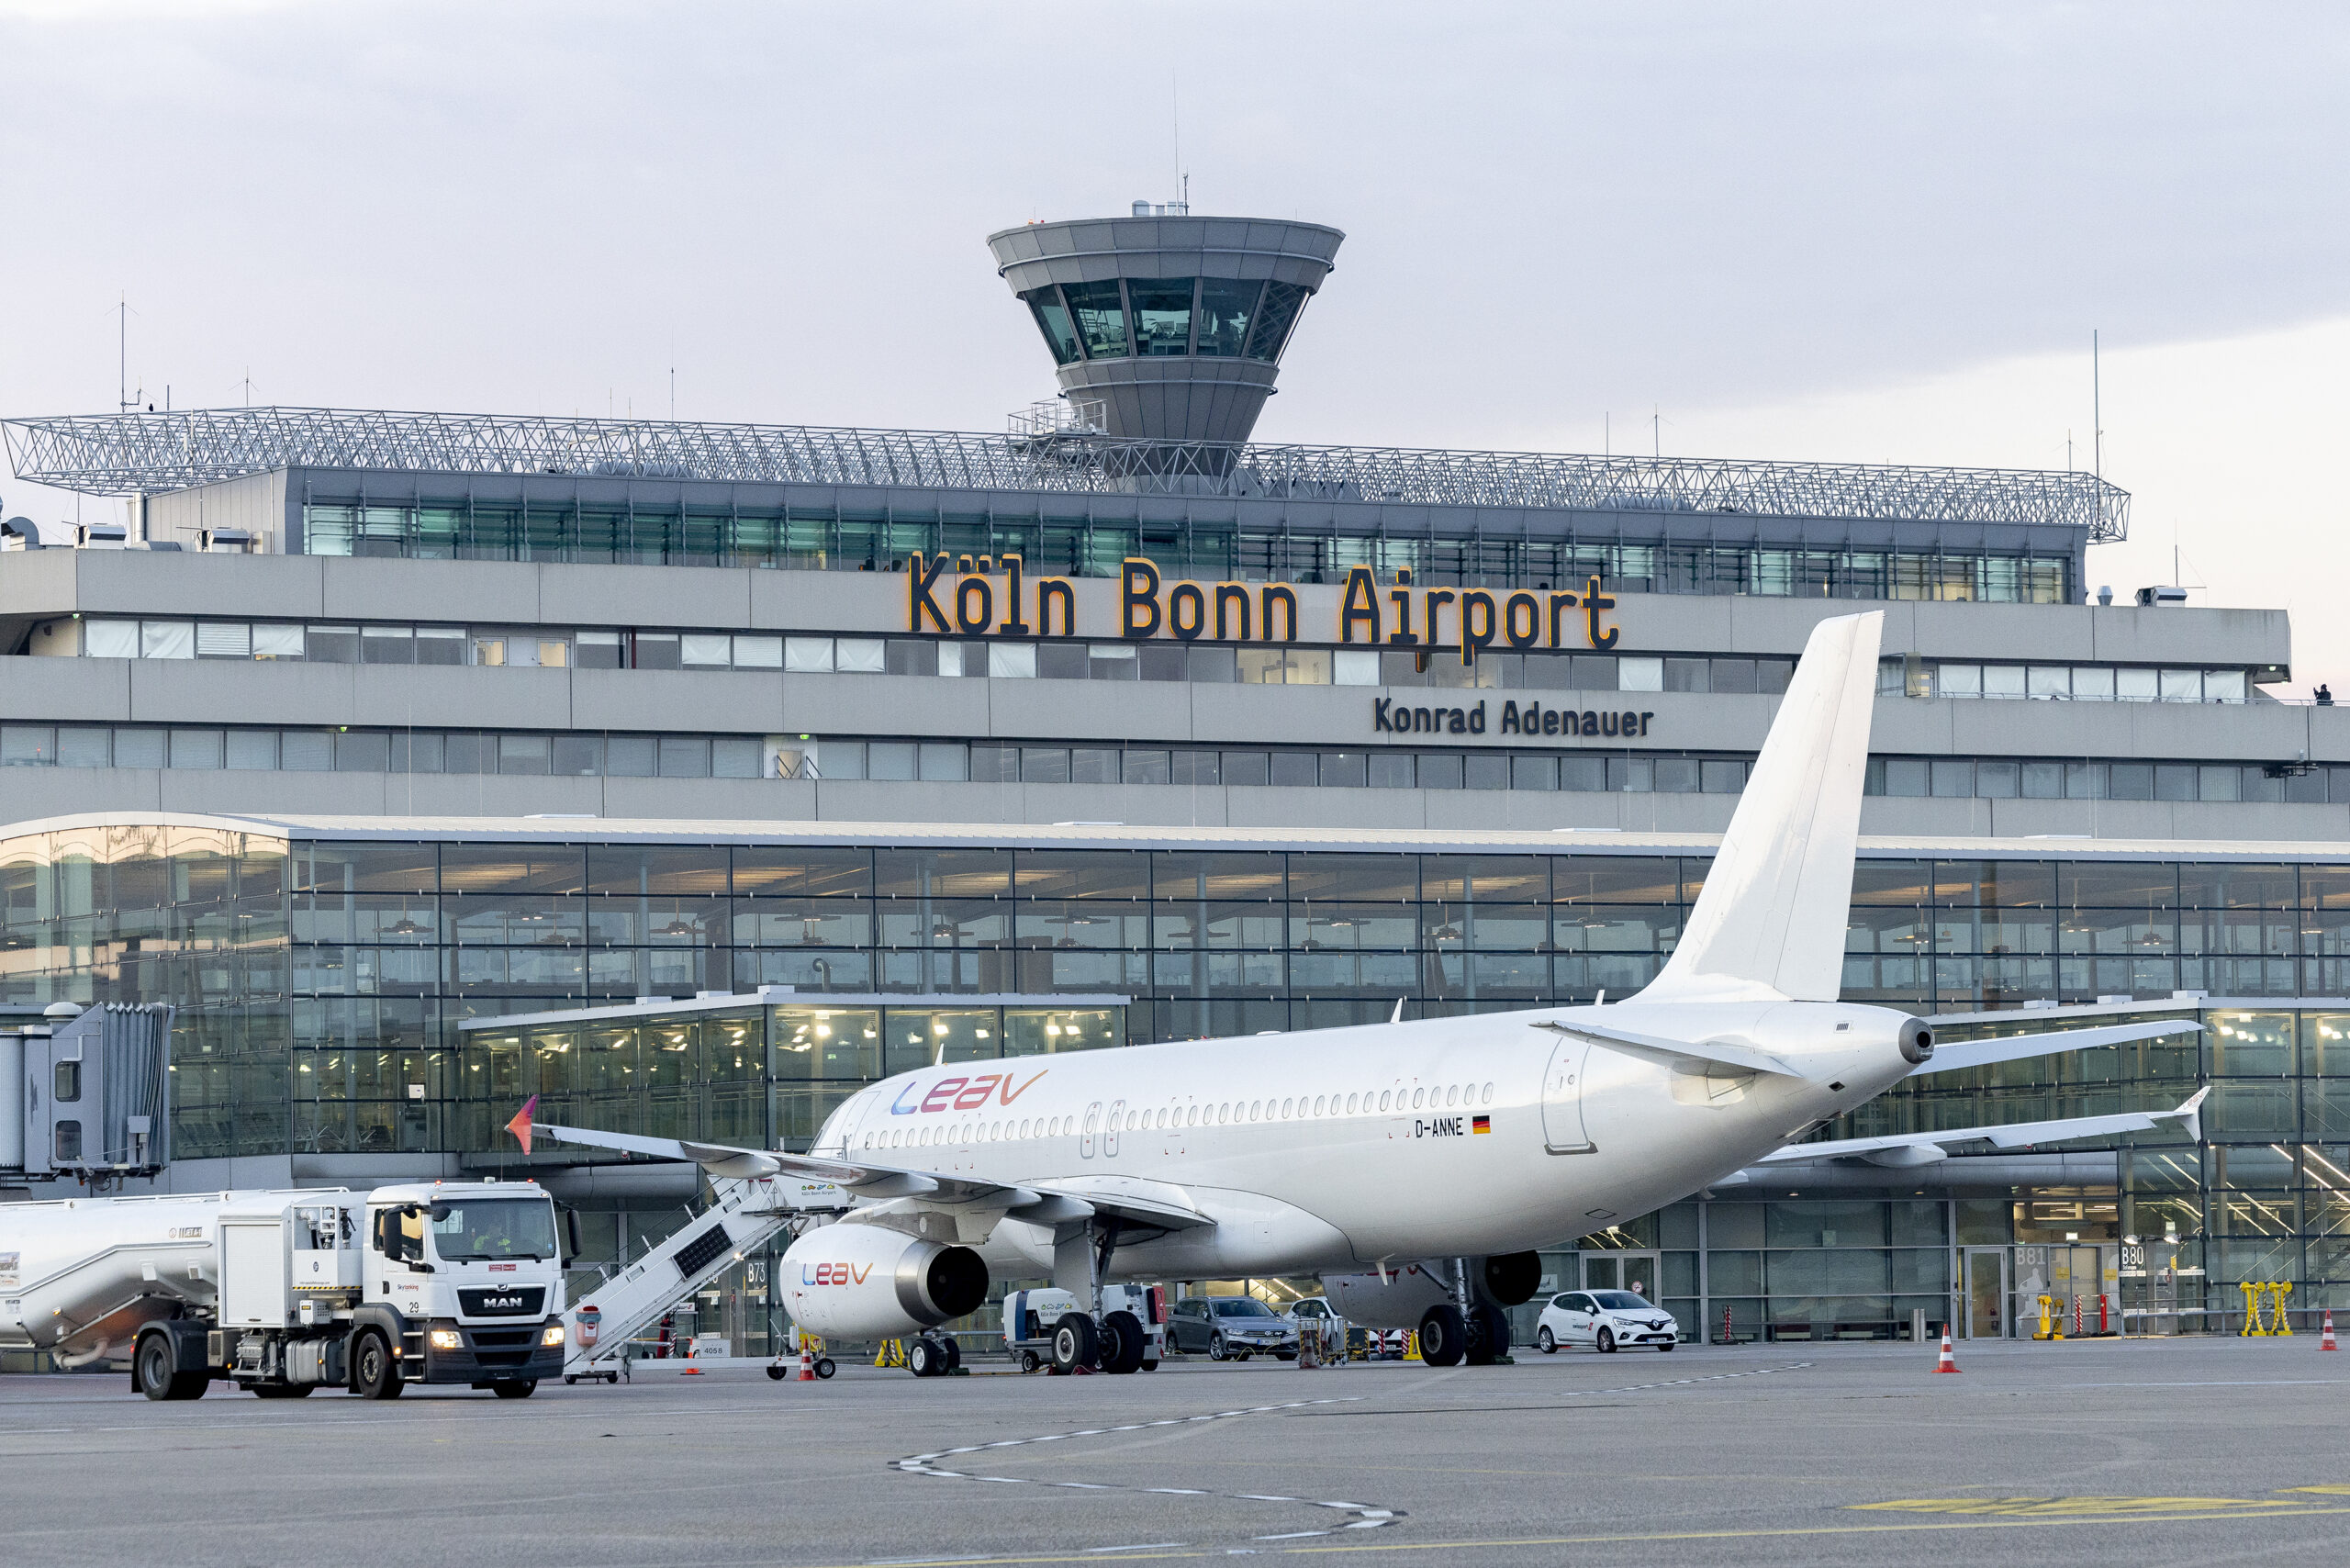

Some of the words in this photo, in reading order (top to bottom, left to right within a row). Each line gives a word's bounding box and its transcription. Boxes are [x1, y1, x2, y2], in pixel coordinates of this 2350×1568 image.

[908, 551, 1076, 636] Köln
[1121, 556, 1298, 643] Bonn
[1340, 564, 1620, 668] Airport
[1373, 698, 1488, 735] Konrad
[1501, 700, 1655, 739] Adenauer
[1416, 1116, 1464, 1138] D-ANNE
[2017, 1248, 2046, 1265] B81
[2121, 1246, 2144, 1265] B80
[748, 1262, 766, 1282] B73
[408, 1302, 420, 1314] 29
[483, 1297, 522, 1308] MAN
